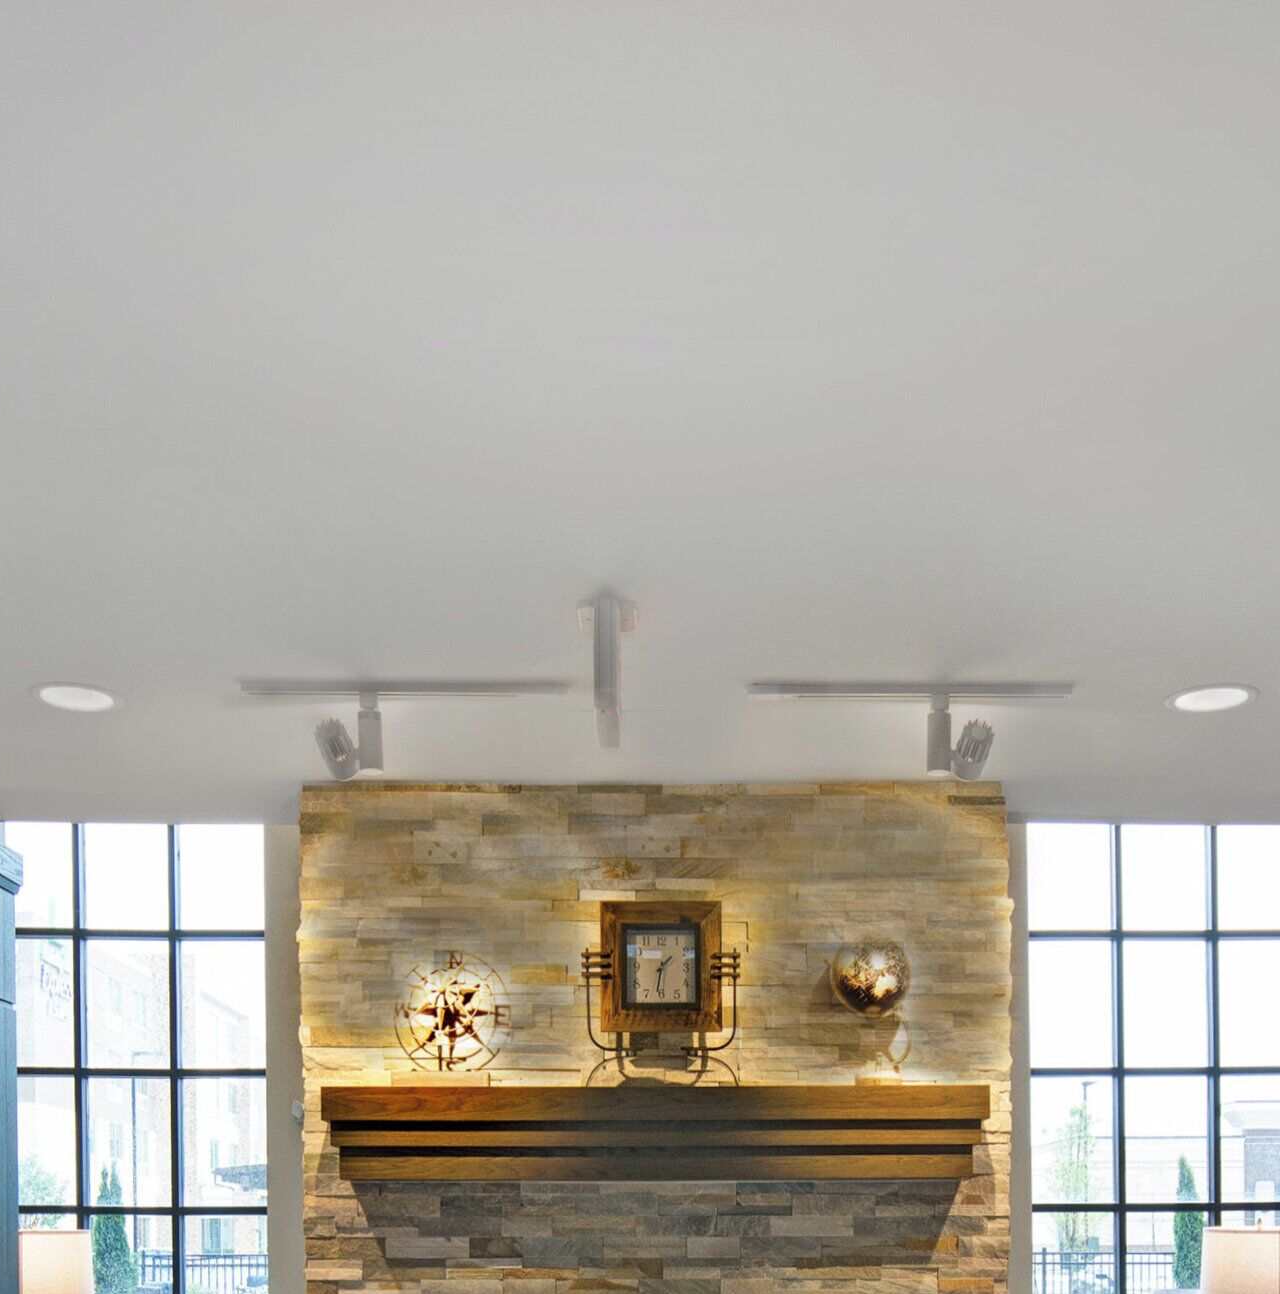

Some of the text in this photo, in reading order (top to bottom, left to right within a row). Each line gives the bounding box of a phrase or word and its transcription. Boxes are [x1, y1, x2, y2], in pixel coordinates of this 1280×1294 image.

[642, 936, 650, 947] 11
[656, 936, 668, 947] 12
[633, 961, 641, 973] 9
[682, 961, 690, 973] 3
[633, 977, 641, 989] 8
[682, 977, 690, 989] 4
[643, 988, 650, 999] 7
[658, 988, 665, 999] 6
[673, 988, 681, 999] 5
[494, 1005, 512, 1027] E
